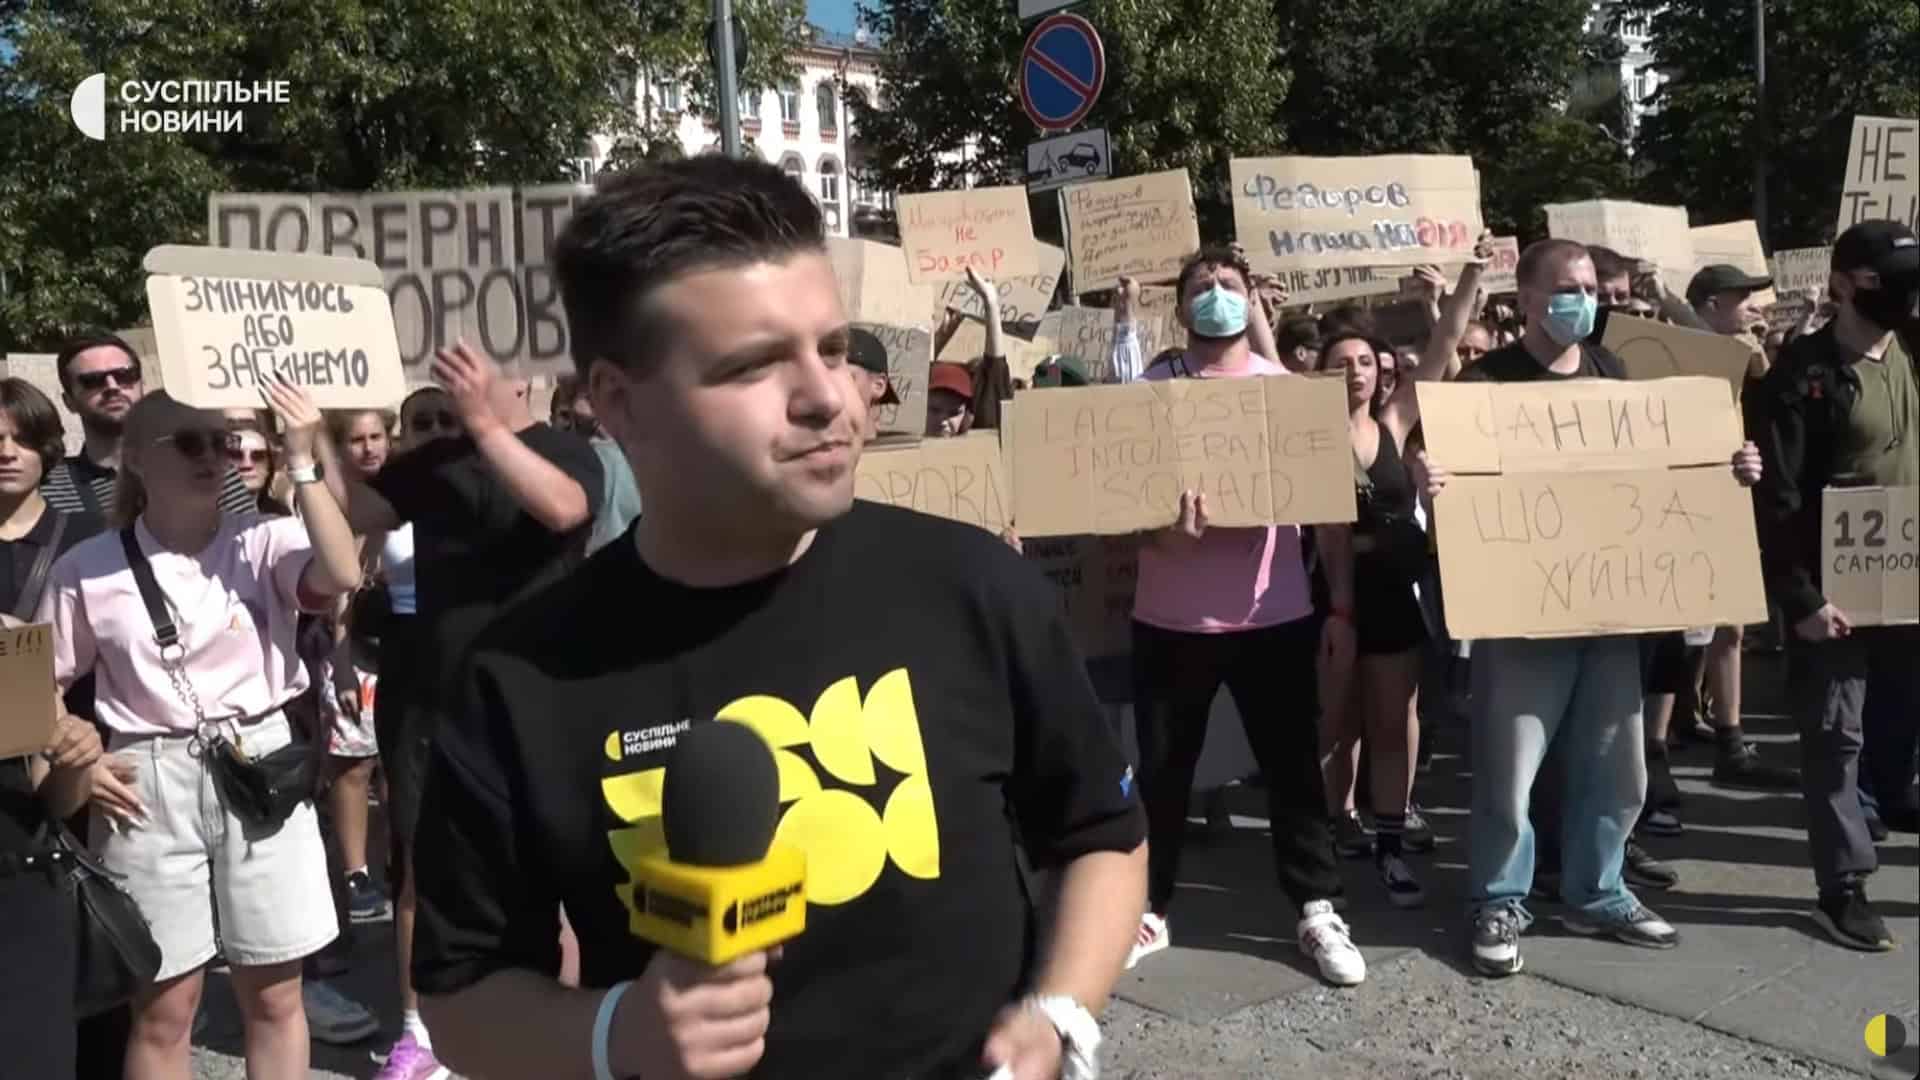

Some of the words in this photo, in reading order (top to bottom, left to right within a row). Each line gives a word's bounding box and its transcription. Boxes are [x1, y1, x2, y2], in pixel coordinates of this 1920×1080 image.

[1858, 126, 1914, 184] НЕ
[218, 192, 580, 270] ПОВЕРНІТ
[181, 277, 354, 313] ЗМІНИМОСЬ
[389, 265, 567, 367] ОРОВ
[244, 314, 294, 347] АБО
[202, 343, 369, 389] ЗАГИНЕМО
[1043, 389, 1273, 443] LACTOSE
[1070, 429, 1333, 478] INTOLERANCE
[1472, 484, 1564, 544] ШО
[1611, 483, 1713, 535] ЗА
[1834, 510, 1886, 547] 12
[1902, 518, 1914, 541] С
[1833, 552, 1918, 575] САМОО
